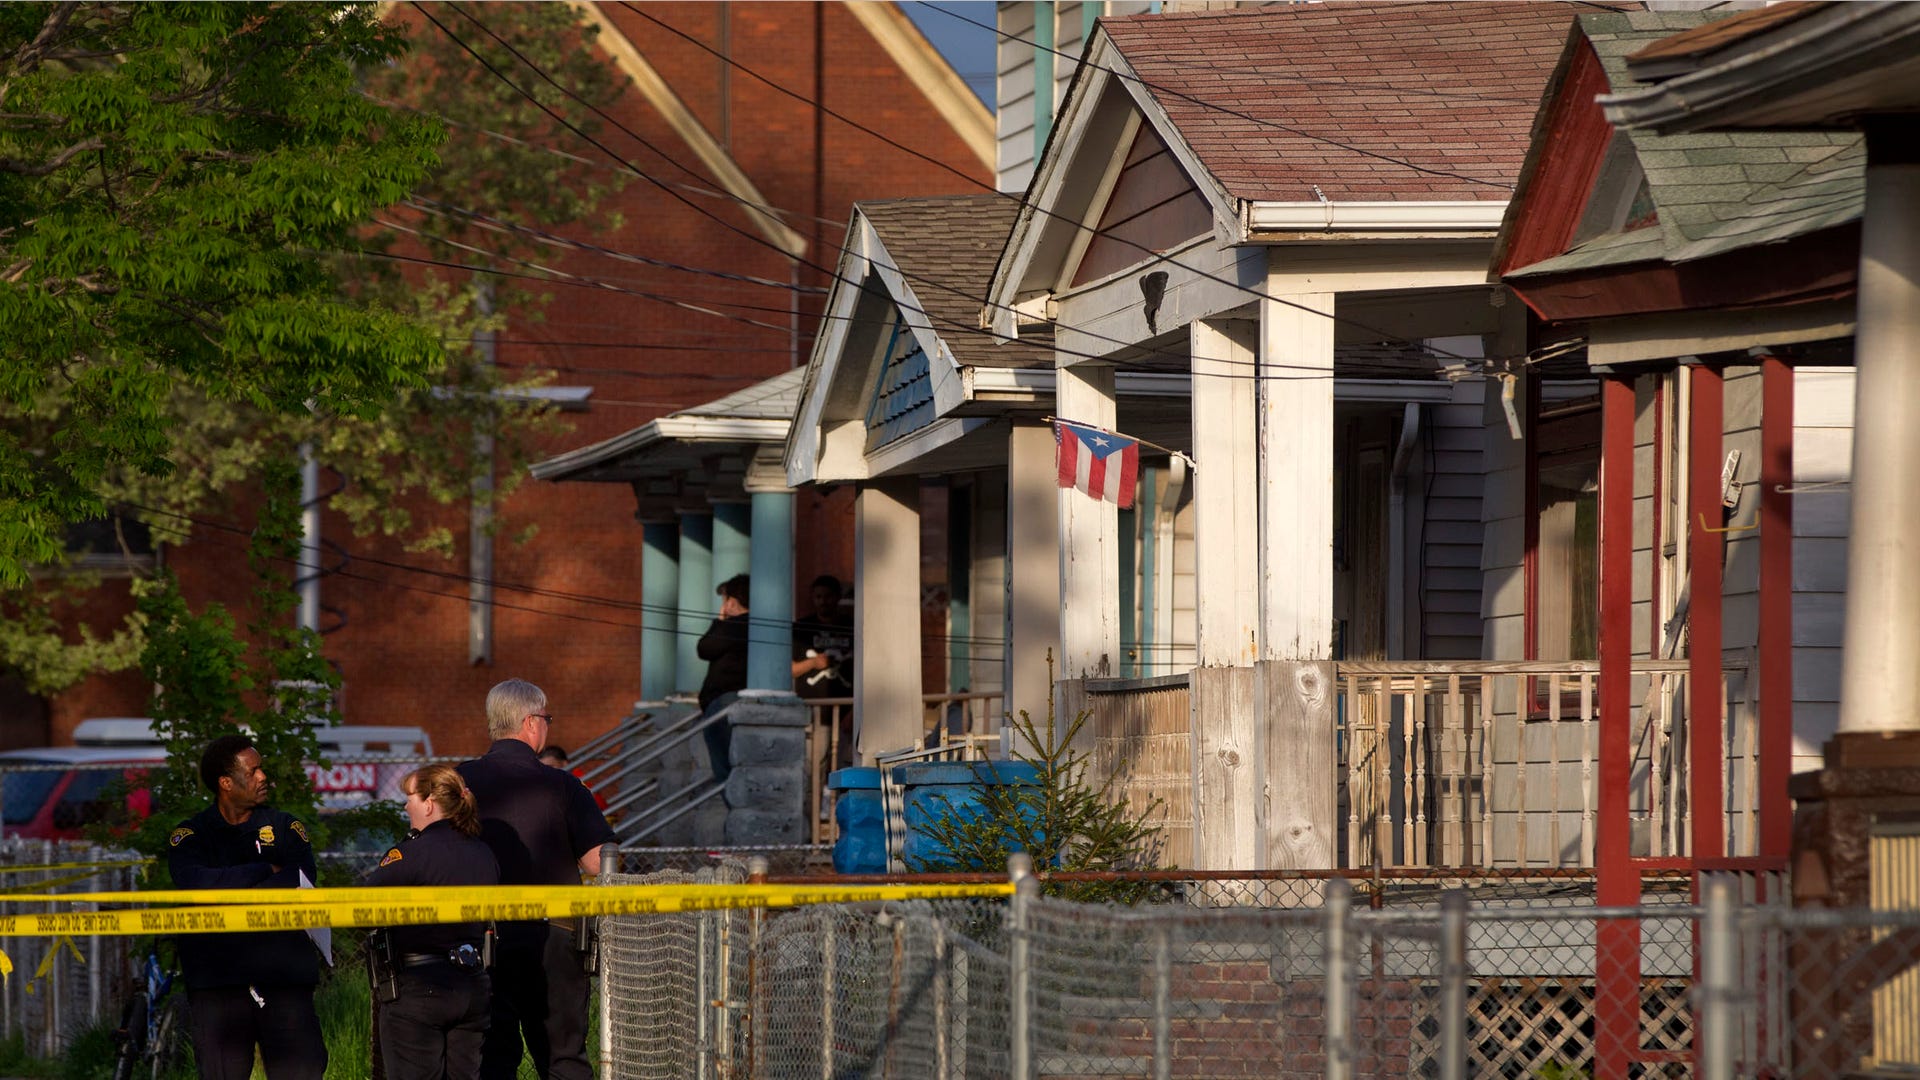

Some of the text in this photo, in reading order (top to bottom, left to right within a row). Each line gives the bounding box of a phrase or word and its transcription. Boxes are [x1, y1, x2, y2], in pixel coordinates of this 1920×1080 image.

[36, 914, 120, 932] POLICE LINE DO NOT CROSS
[141, 911, 225, 930] POLICE LINE DO NOT CROSS
[246, 909, 331, 928] POLICE LINE DO NOT CROSS
[353, 907, 374, 926] CROSS
[375, 907, 387, 925] NOT
[400, 906, 415, 924] LINE
[416, 906, 438, 923] POLICE
